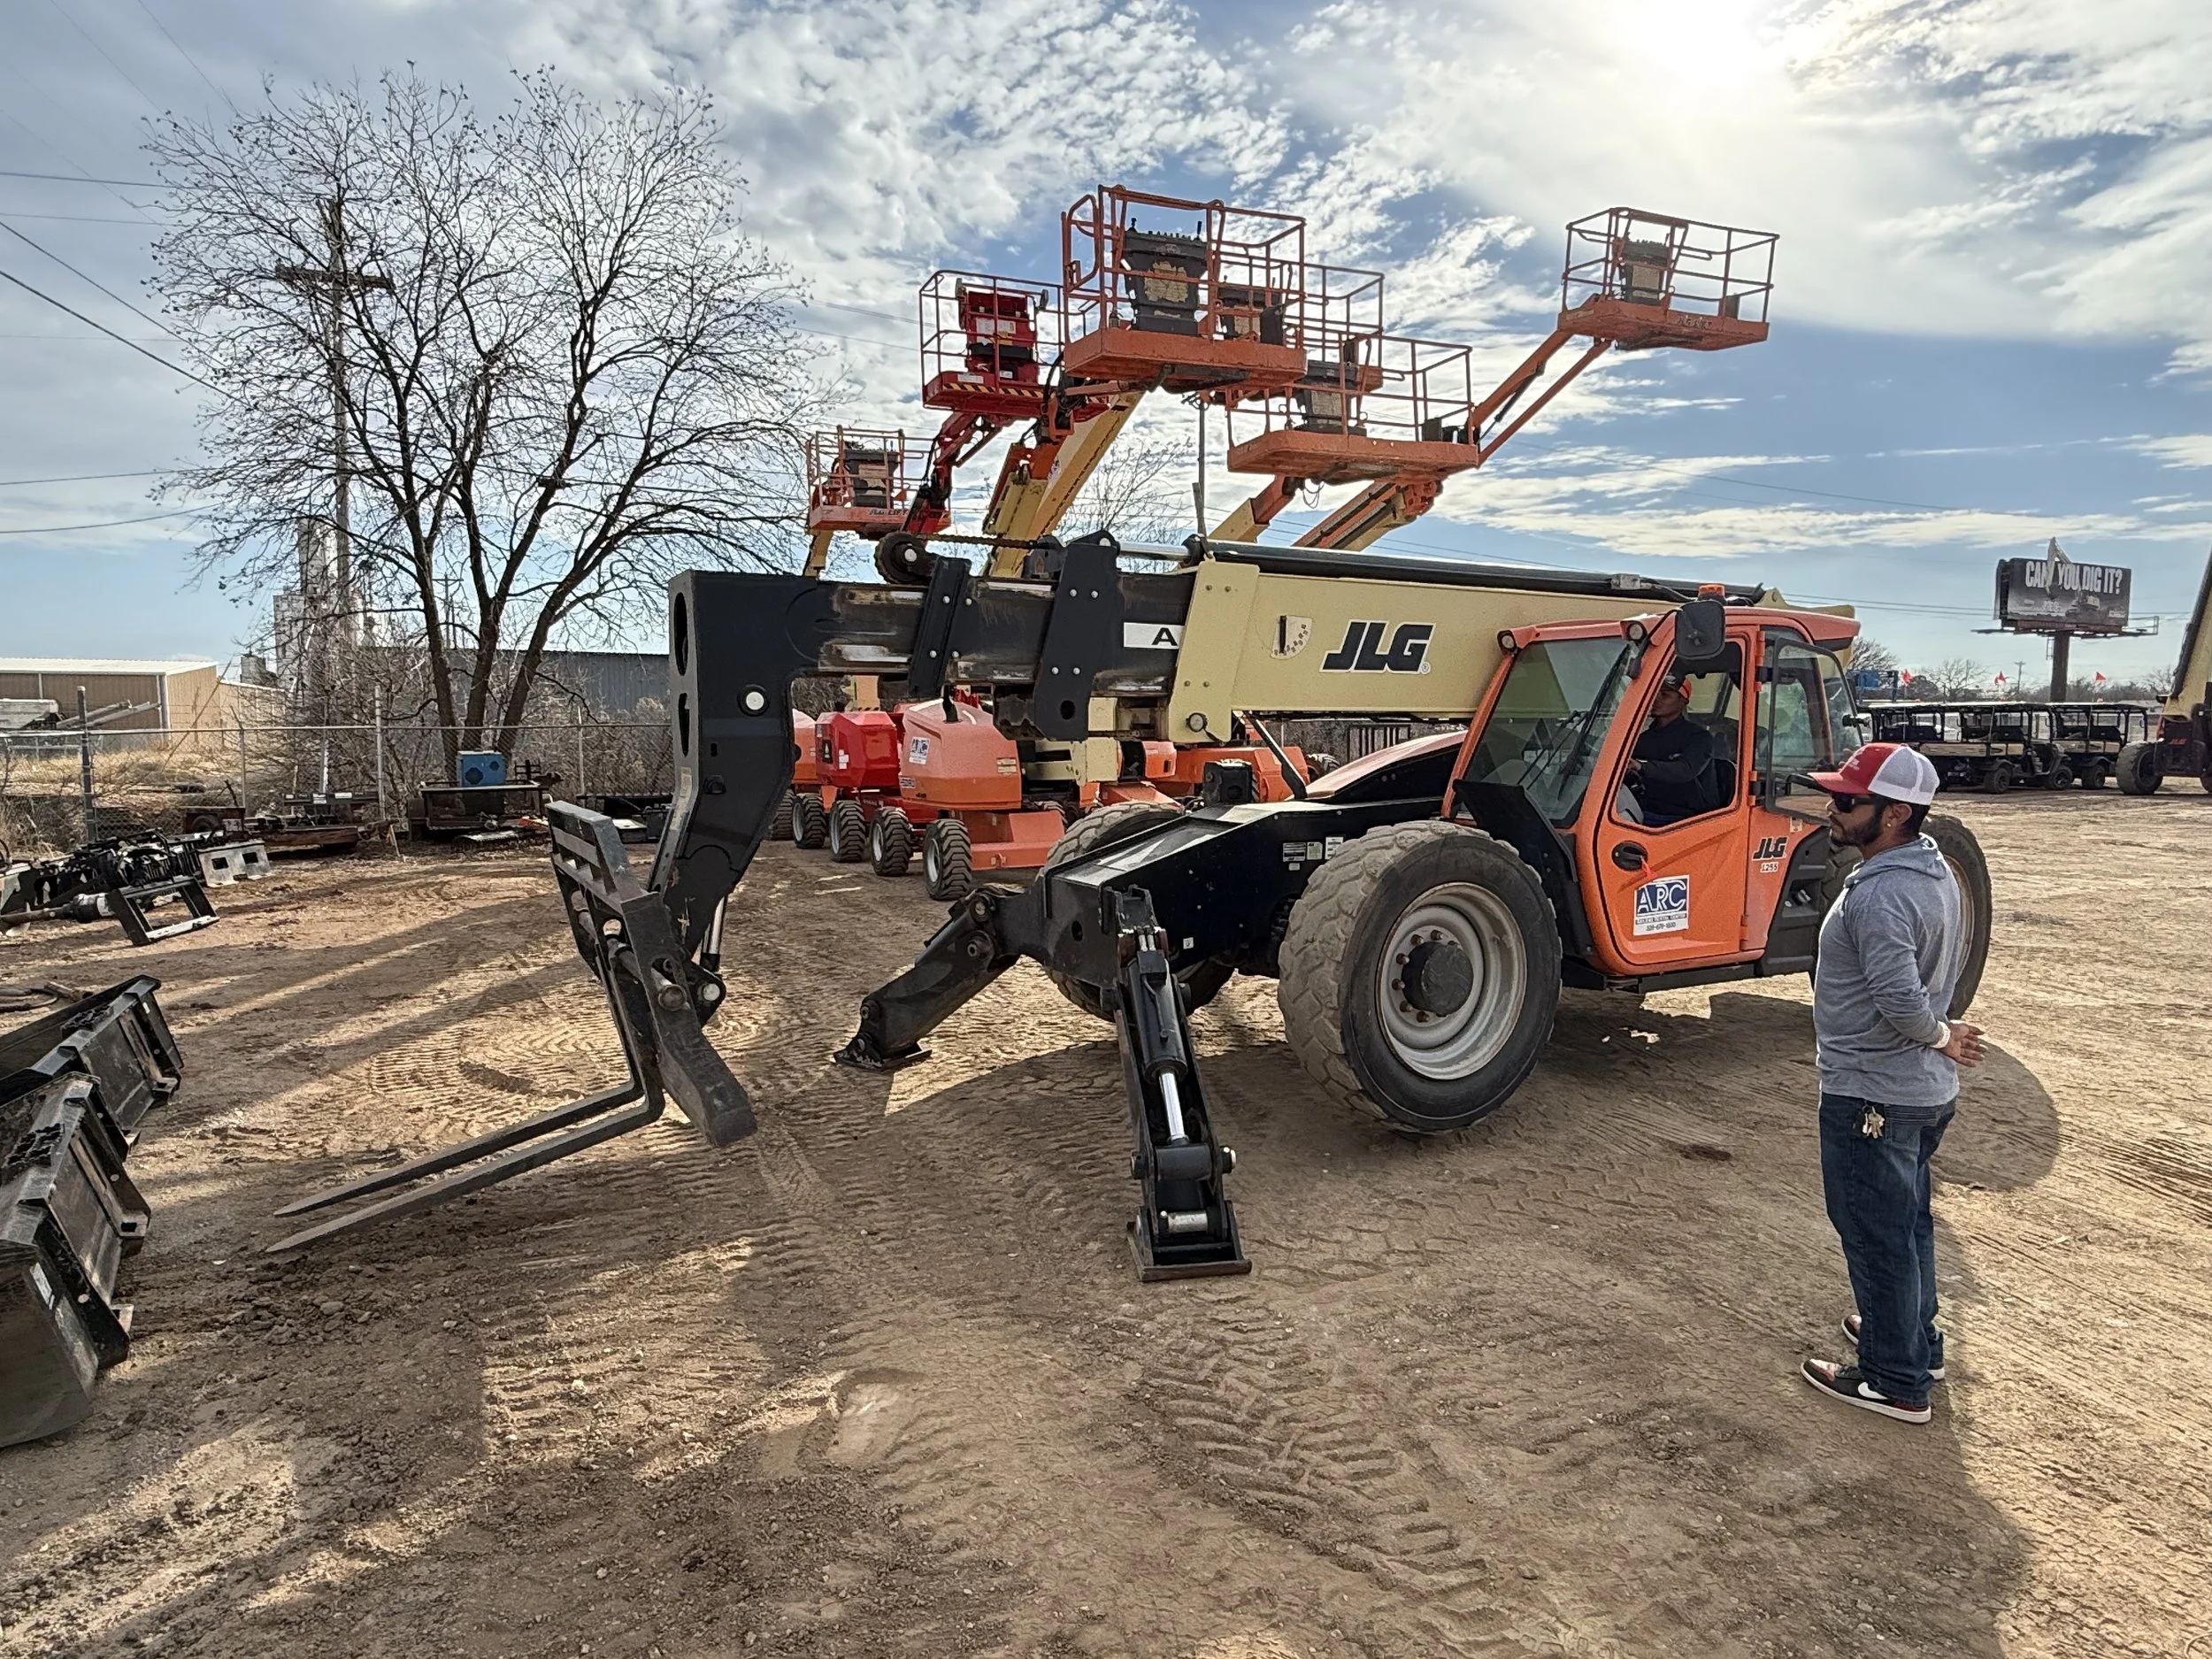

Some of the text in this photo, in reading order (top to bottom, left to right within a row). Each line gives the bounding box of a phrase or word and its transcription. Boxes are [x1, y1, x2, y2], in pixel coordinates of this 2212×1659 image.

[2057, 564, 2081, 591] YOU
[2082, 566, 2102, 593] DIG
[2103, 568, 2123, 595] IT?
[1152, 627, 1178, 646] A
[1322, 621, 1434, 672] JLG
[1753, 836, 1787, 859] JLG
[1637, 879, 1686, 913] ARC
